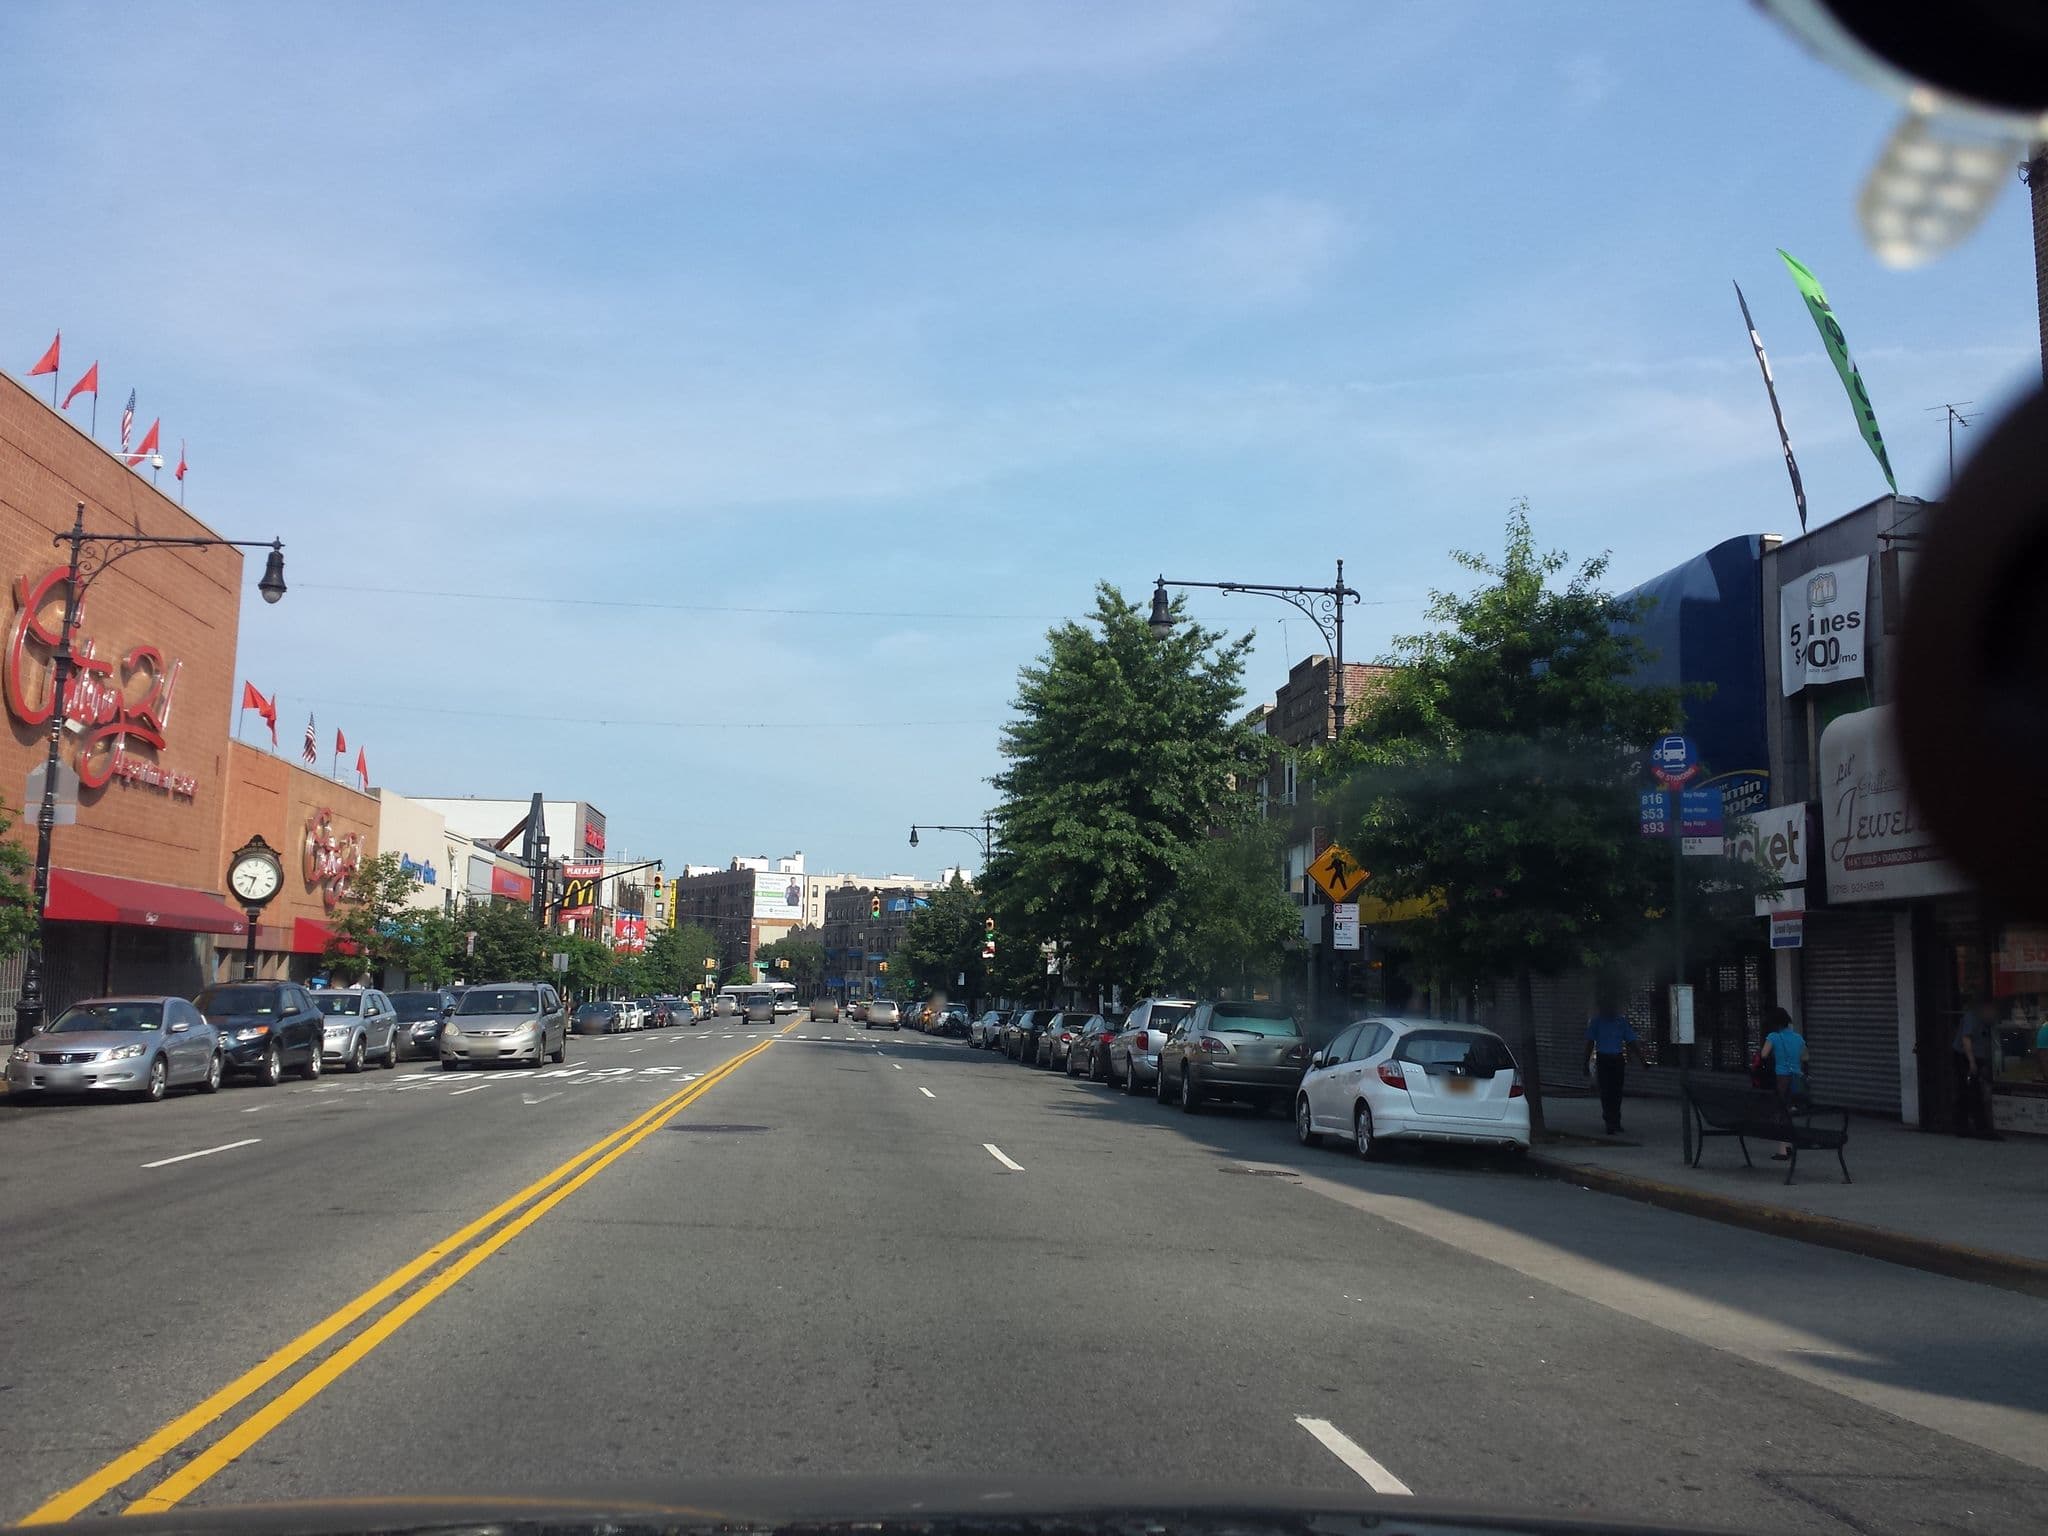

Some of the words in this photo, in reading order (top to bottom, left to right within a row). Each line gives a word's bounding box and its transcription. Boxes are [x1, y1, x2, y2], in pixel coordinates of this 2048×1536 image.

[1790, 623, 1800, 646] 5
[1642, 793, 1663, 805] B16
[1642, 808, 1664, 820] S53
[1643, 822, 1665, 834] S93
